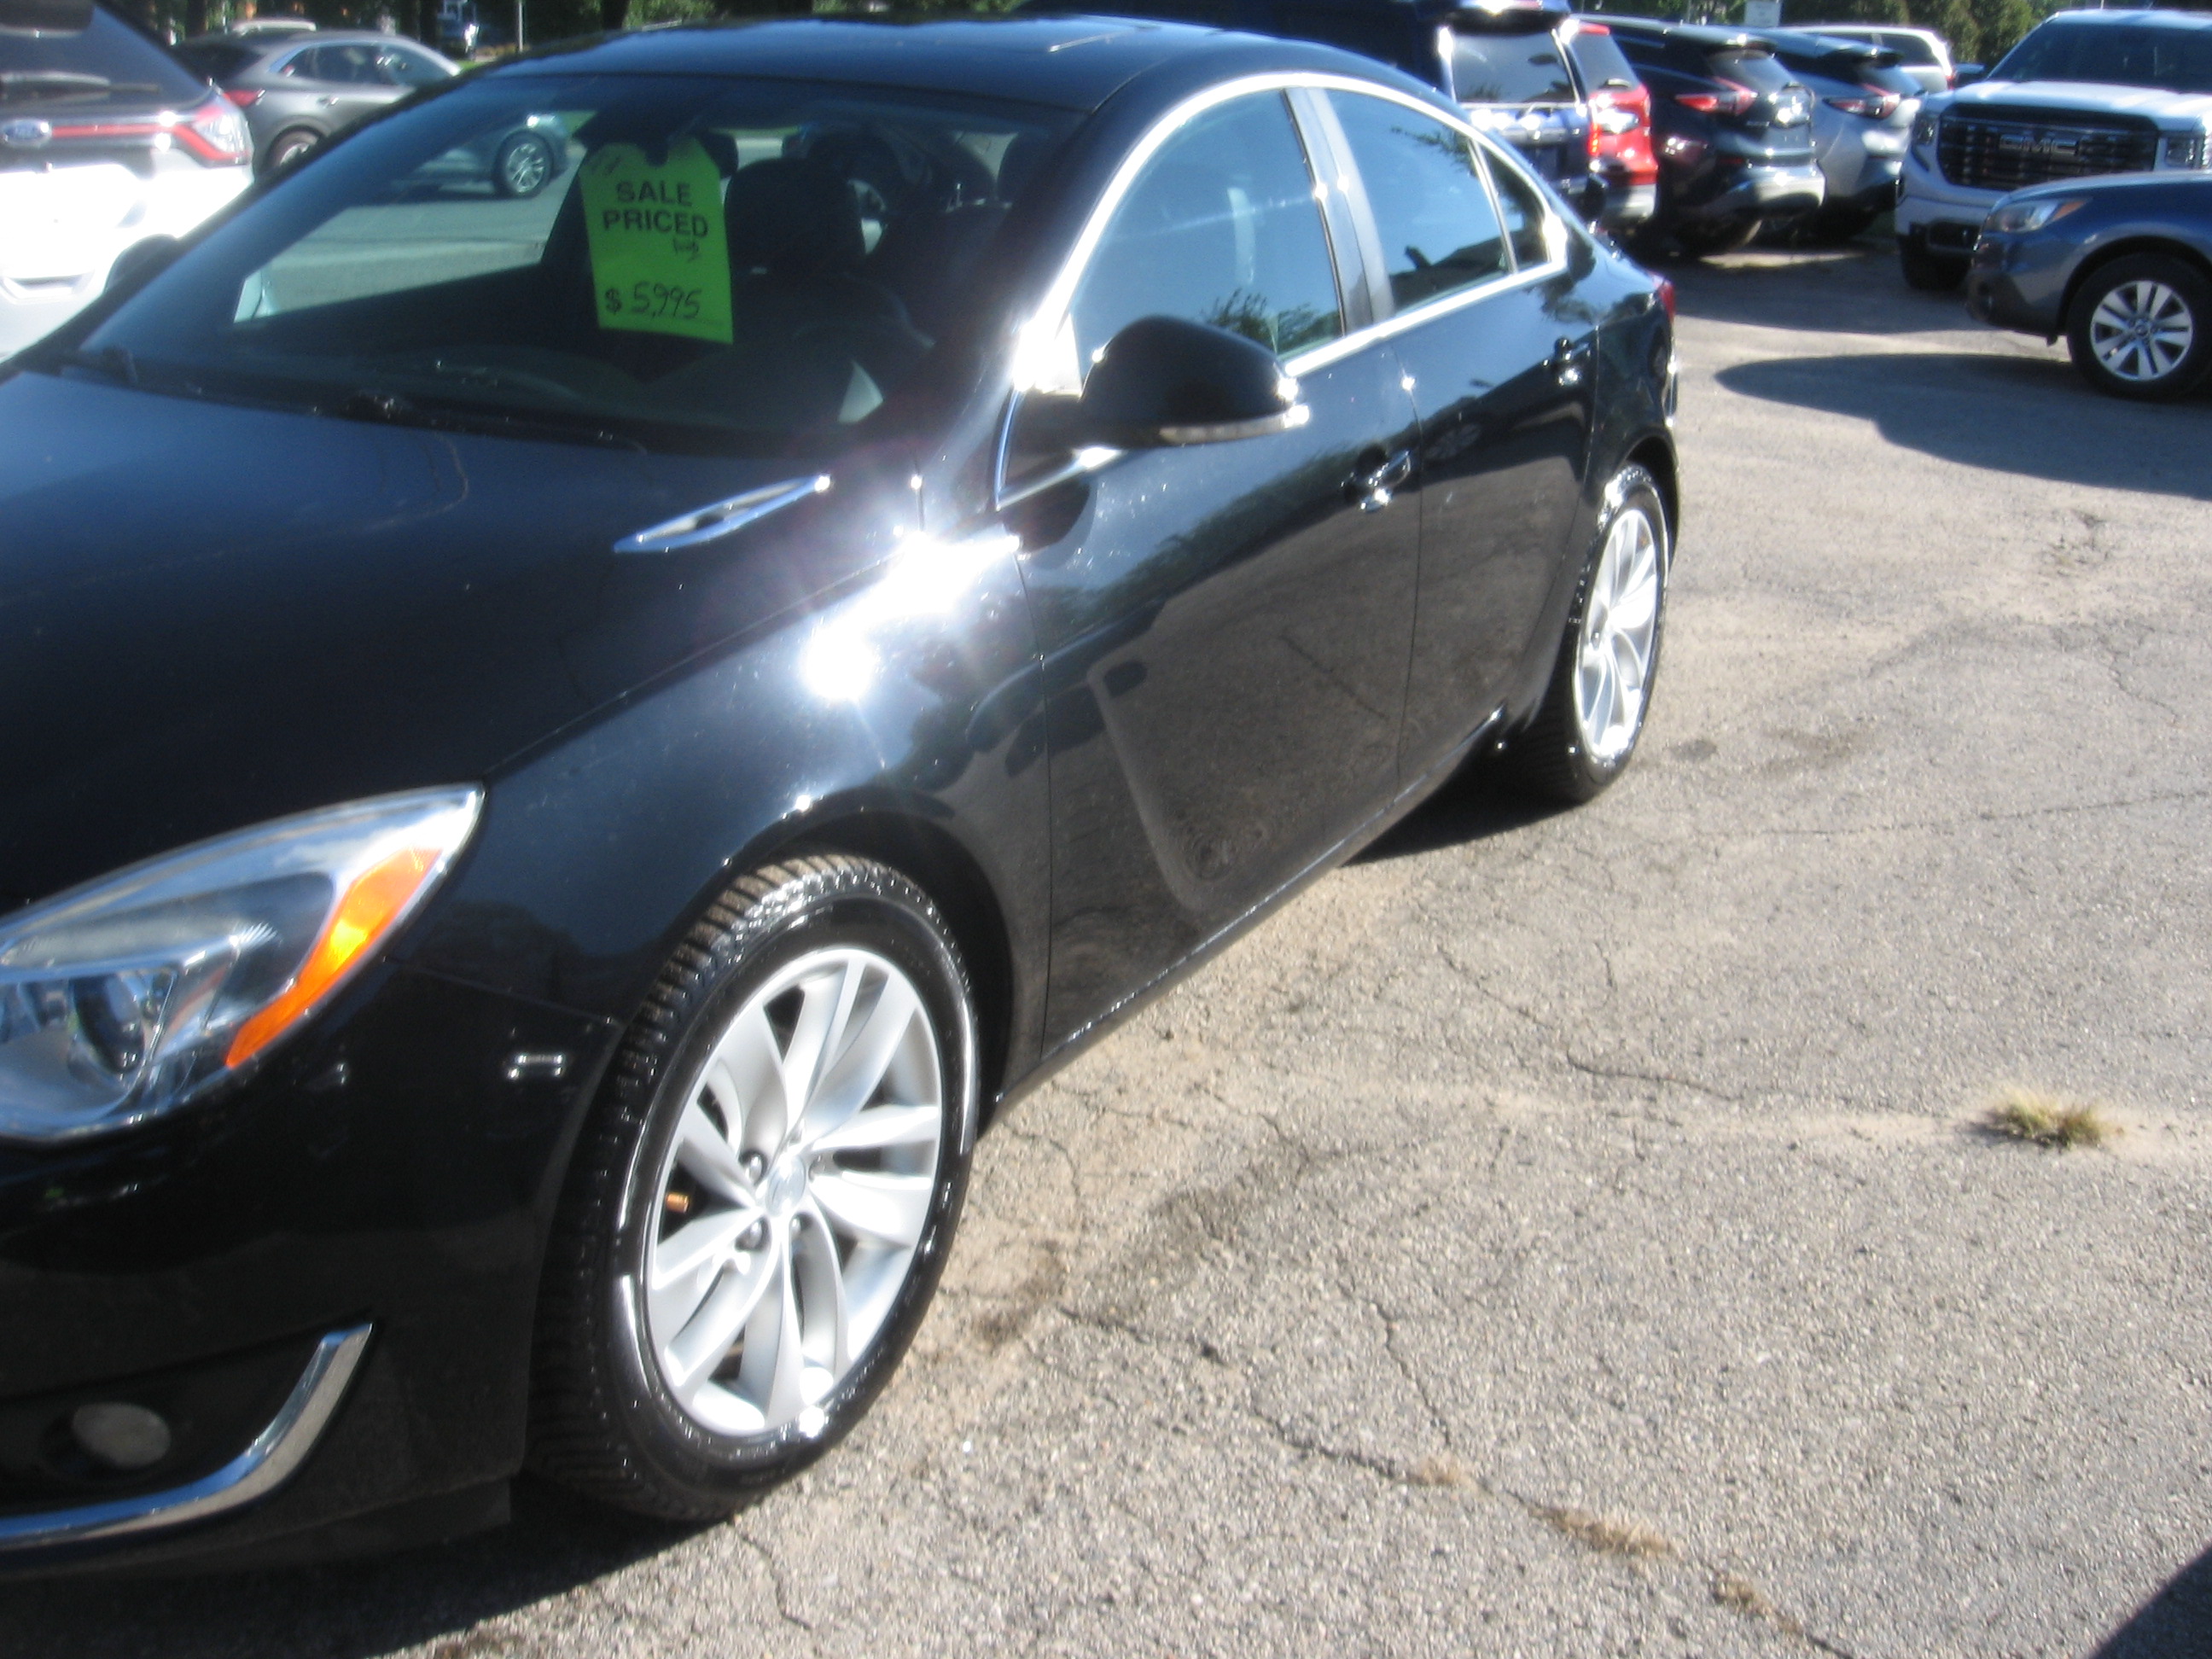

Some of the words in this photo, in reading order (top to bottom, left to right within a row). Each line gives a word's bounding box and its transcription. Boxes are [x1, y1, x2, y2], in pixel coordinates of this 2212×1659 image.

[2000, 134, 2076, 155] GMC
[616, 180, 693, 207] SALE
[602, 209, 708, 238] PRICED
